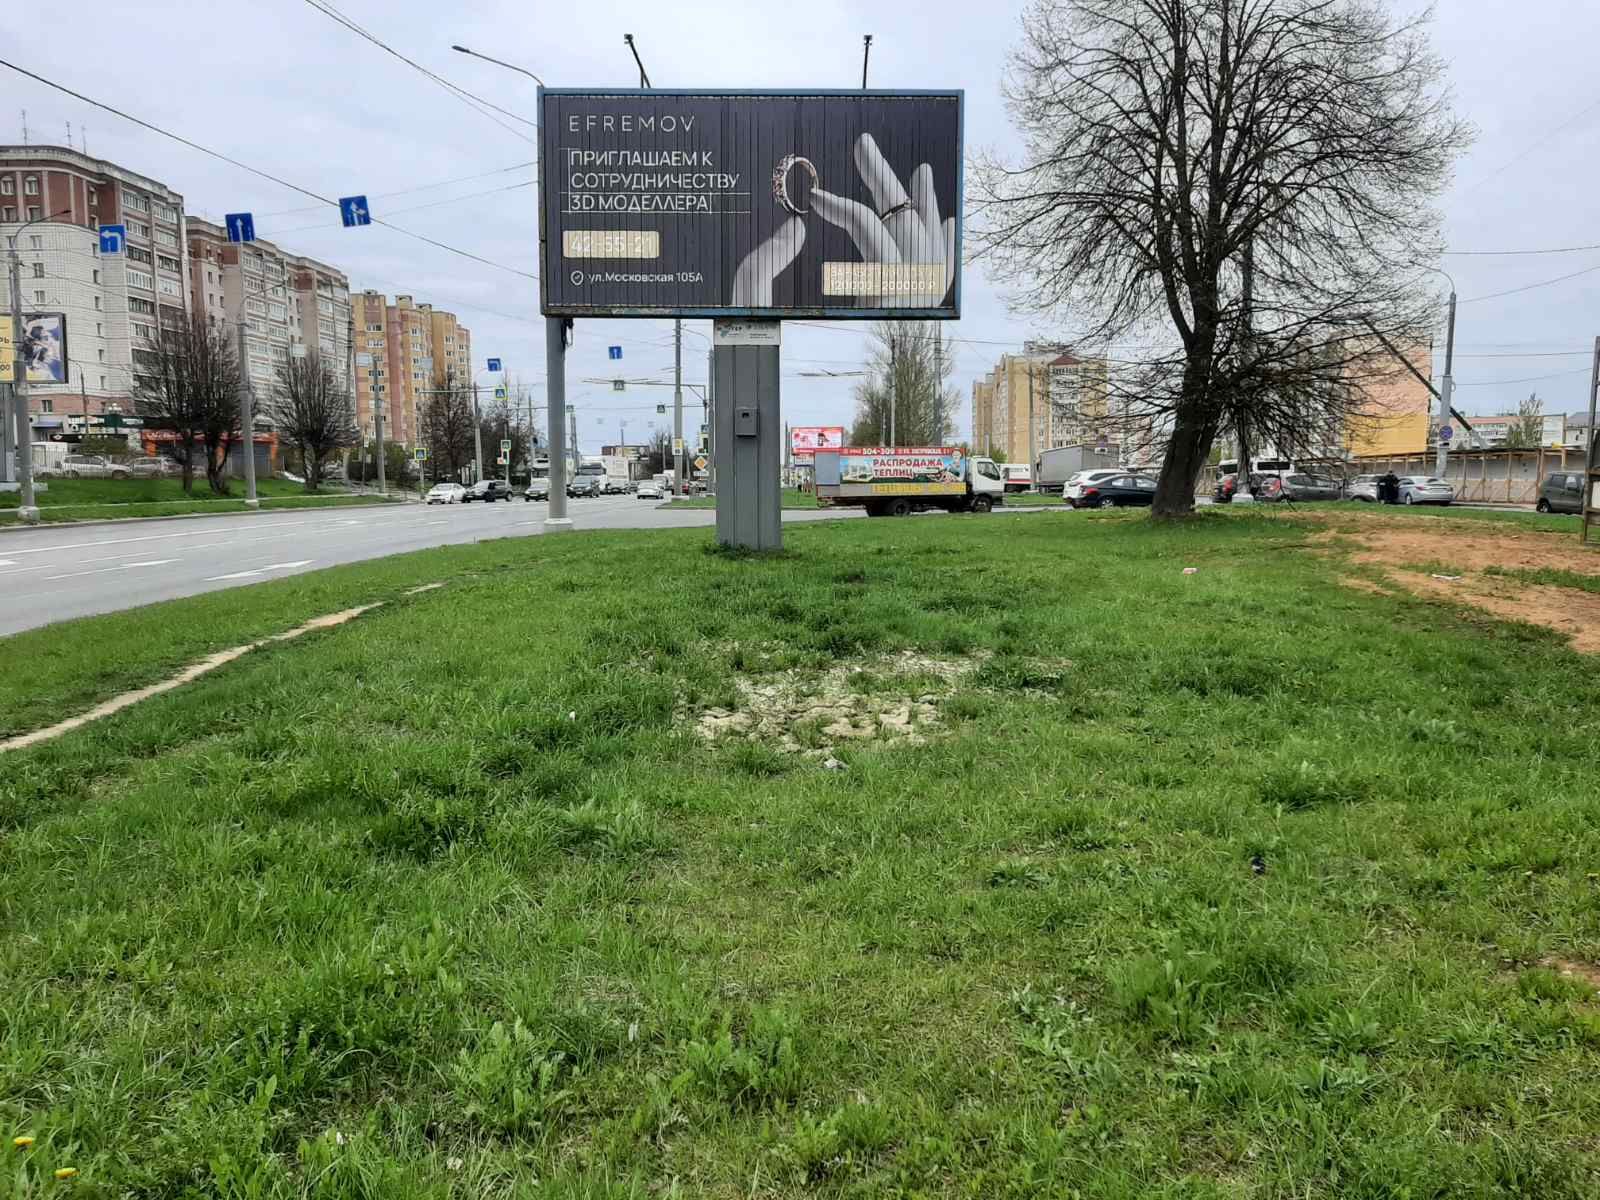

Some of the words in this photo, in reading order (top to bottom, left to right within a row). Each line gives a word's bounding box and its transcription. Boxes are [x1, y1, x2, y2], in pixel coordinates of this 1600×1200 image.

[569, 115, 694, 132] EFREMOV
[571, 151, 697, 166] ПРИГЛАШАЕМ
[702, 151, 713, 166] К
[571, 173, 740, 190] СОТРУДНИЧЕСТВУ
[571, 195, 595, 211] 3D
[599, 195, 708, 212] МОДЕЛЛЕРА
[873, 459, 943, 467] РАСПРОДАЖА
[873, 469, 913, 478] ТЕПЛИЦ
